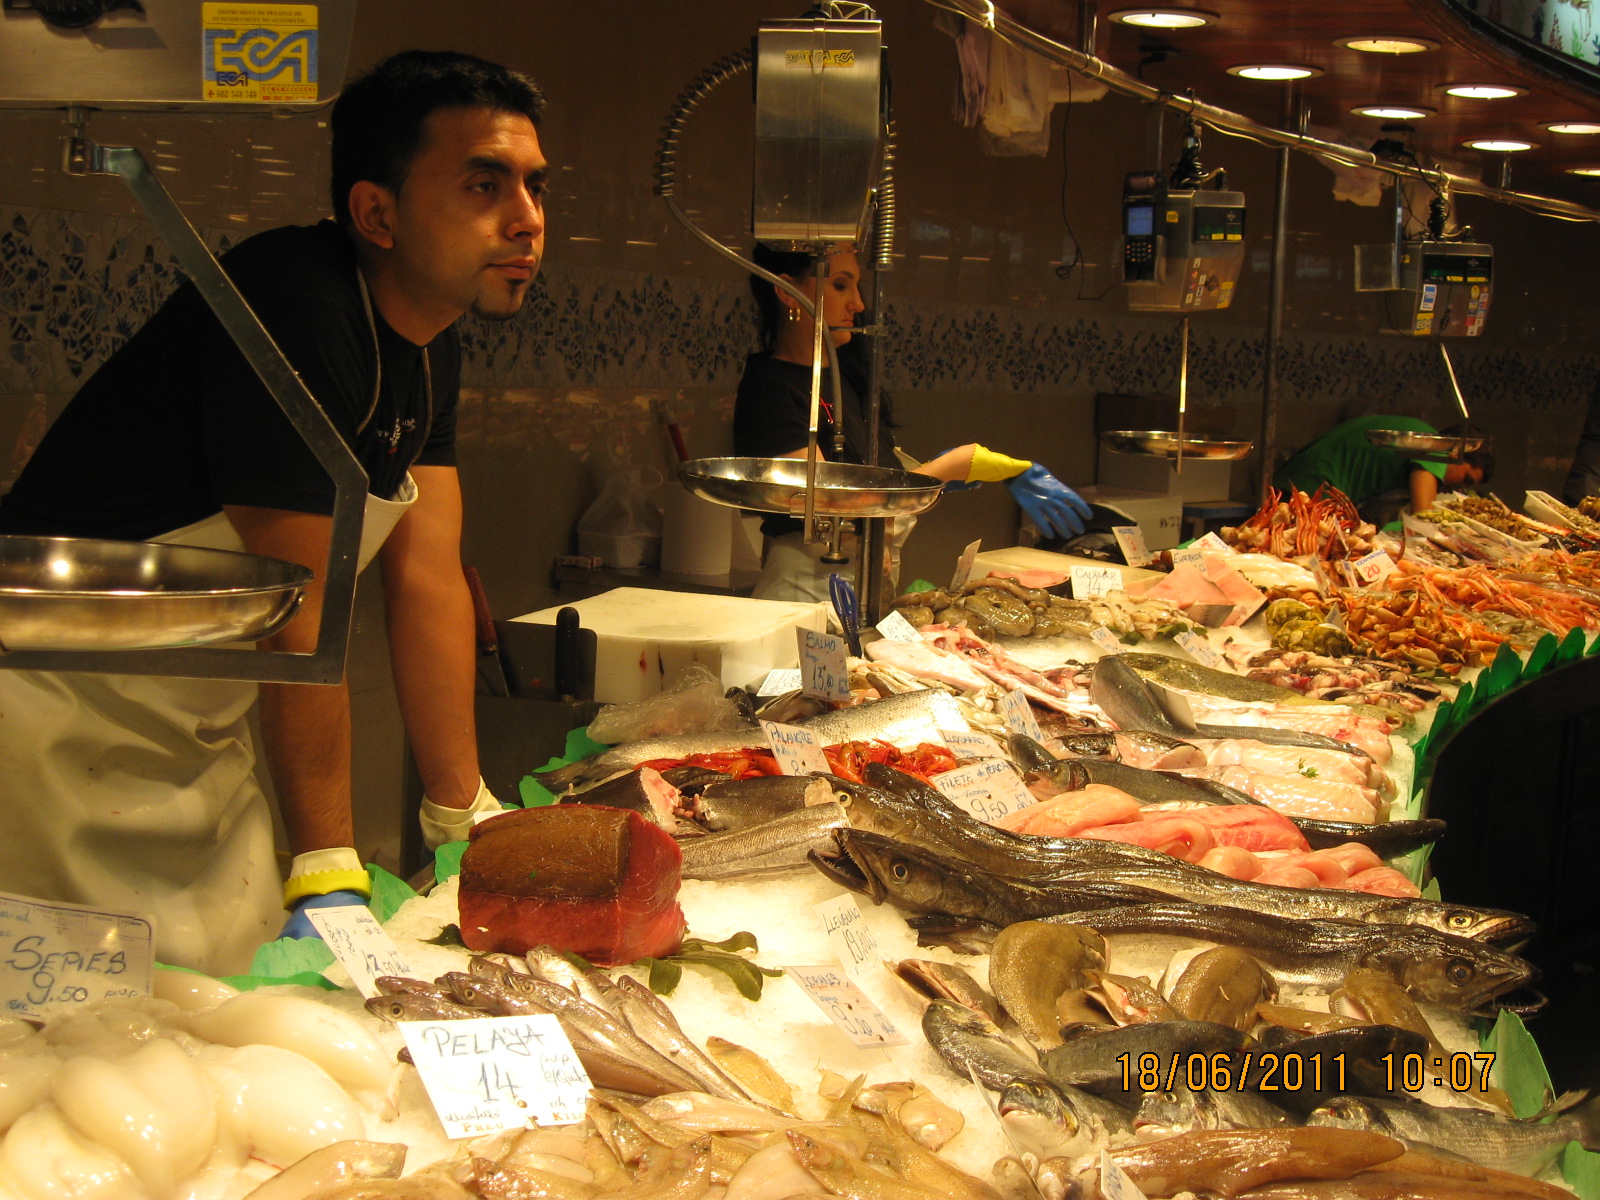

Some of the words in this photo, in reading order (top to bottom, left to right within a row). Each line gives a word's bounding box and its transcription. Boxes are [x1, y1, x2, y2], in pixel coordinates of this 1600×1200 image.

[204, 28, 318, 82] ECA
[216, 71, 248, 86] ECA
[1363, 563, 1380, 578] 20
[1086, 579, 1104, 596] 14
[5, 935, 127, 975] SEPIES
[477, 1061, 523, 1103] 14
